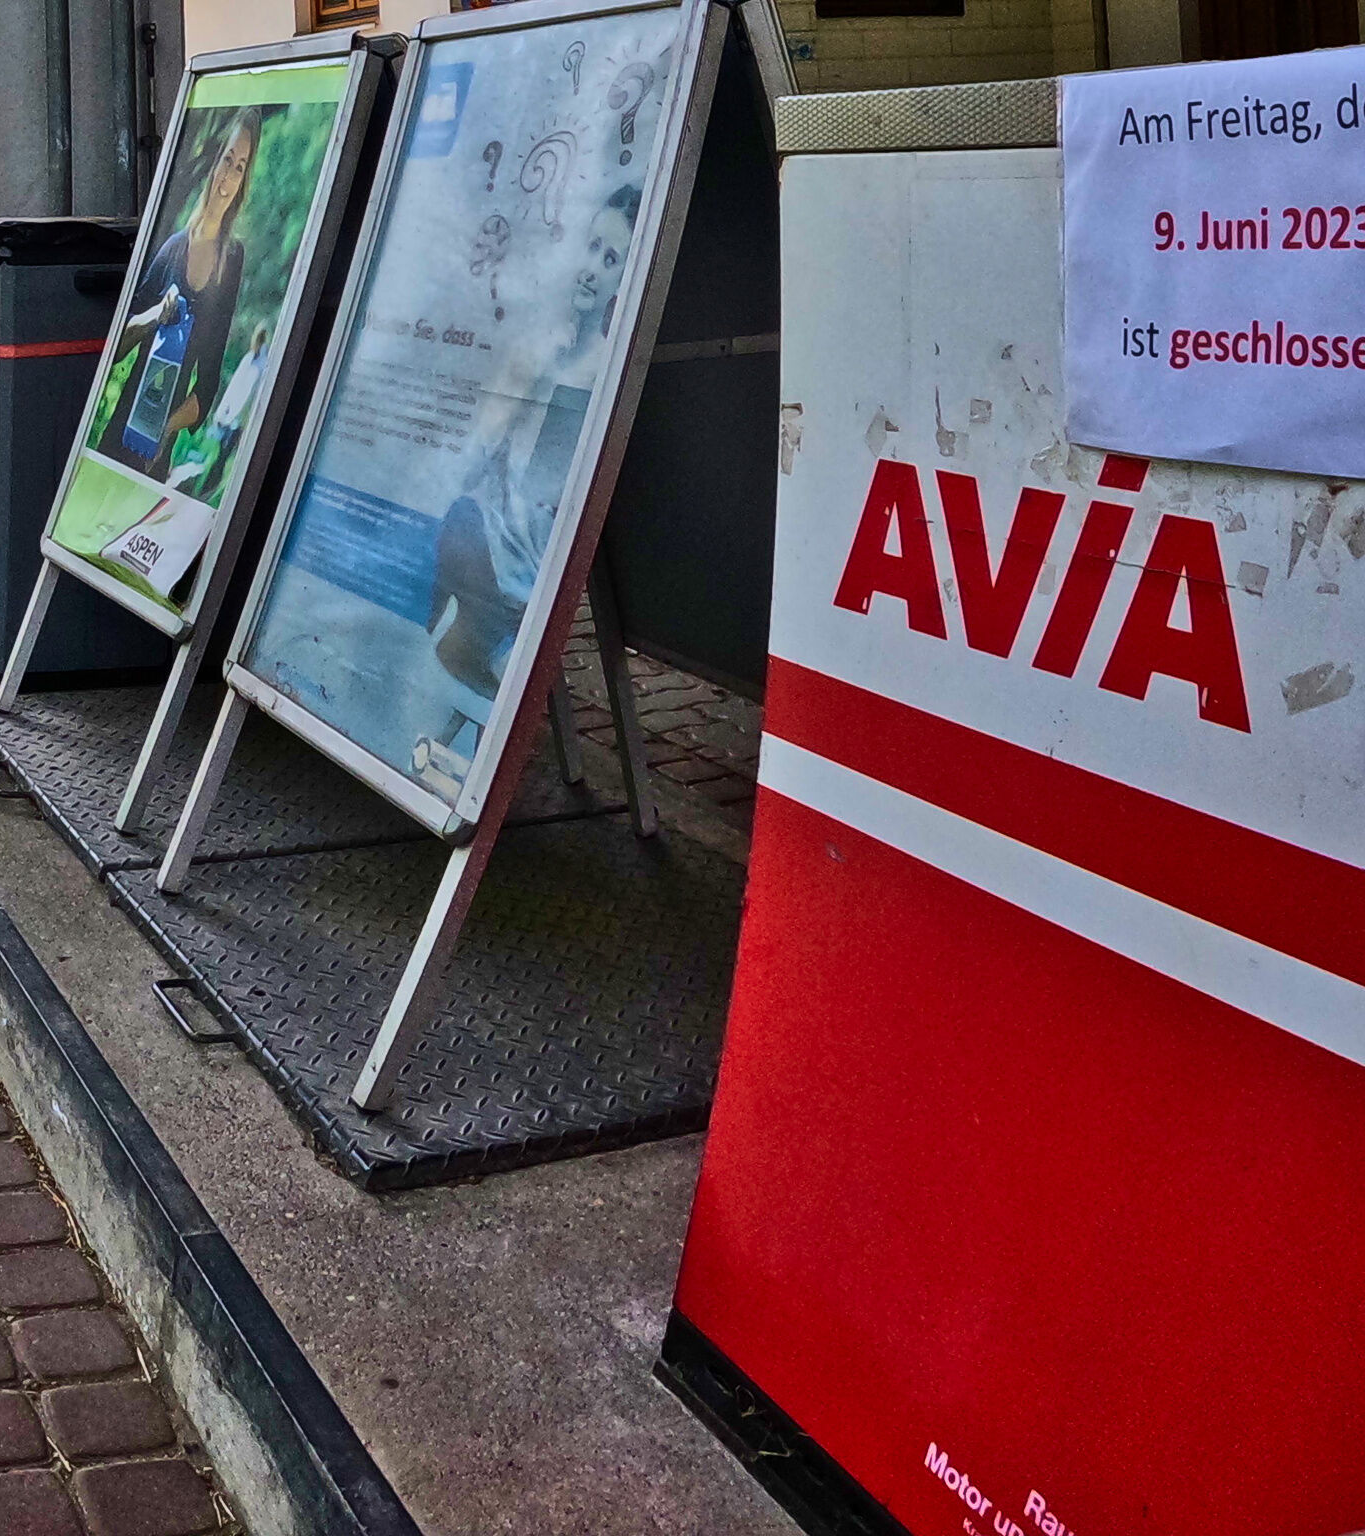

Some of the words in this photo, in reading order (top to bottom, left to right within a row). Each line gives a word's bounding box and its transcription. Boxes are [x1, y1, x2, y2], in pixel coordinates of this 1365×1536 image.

[1118, 106, 1175, 146] Am
[1187, 96, 1323, 144] Freitag,
[1337, 82, 1365, 129] d
[1154, 213, 1186, 252] 9.
[1196, 207, 1270, 251] Juni
[1121, 317, 1160, 359] ist
[124, 532, 165, 567] ASPEN
[832, 453, 1252, 733] AVIA
[924, 1441, 993, 1517] Motor
